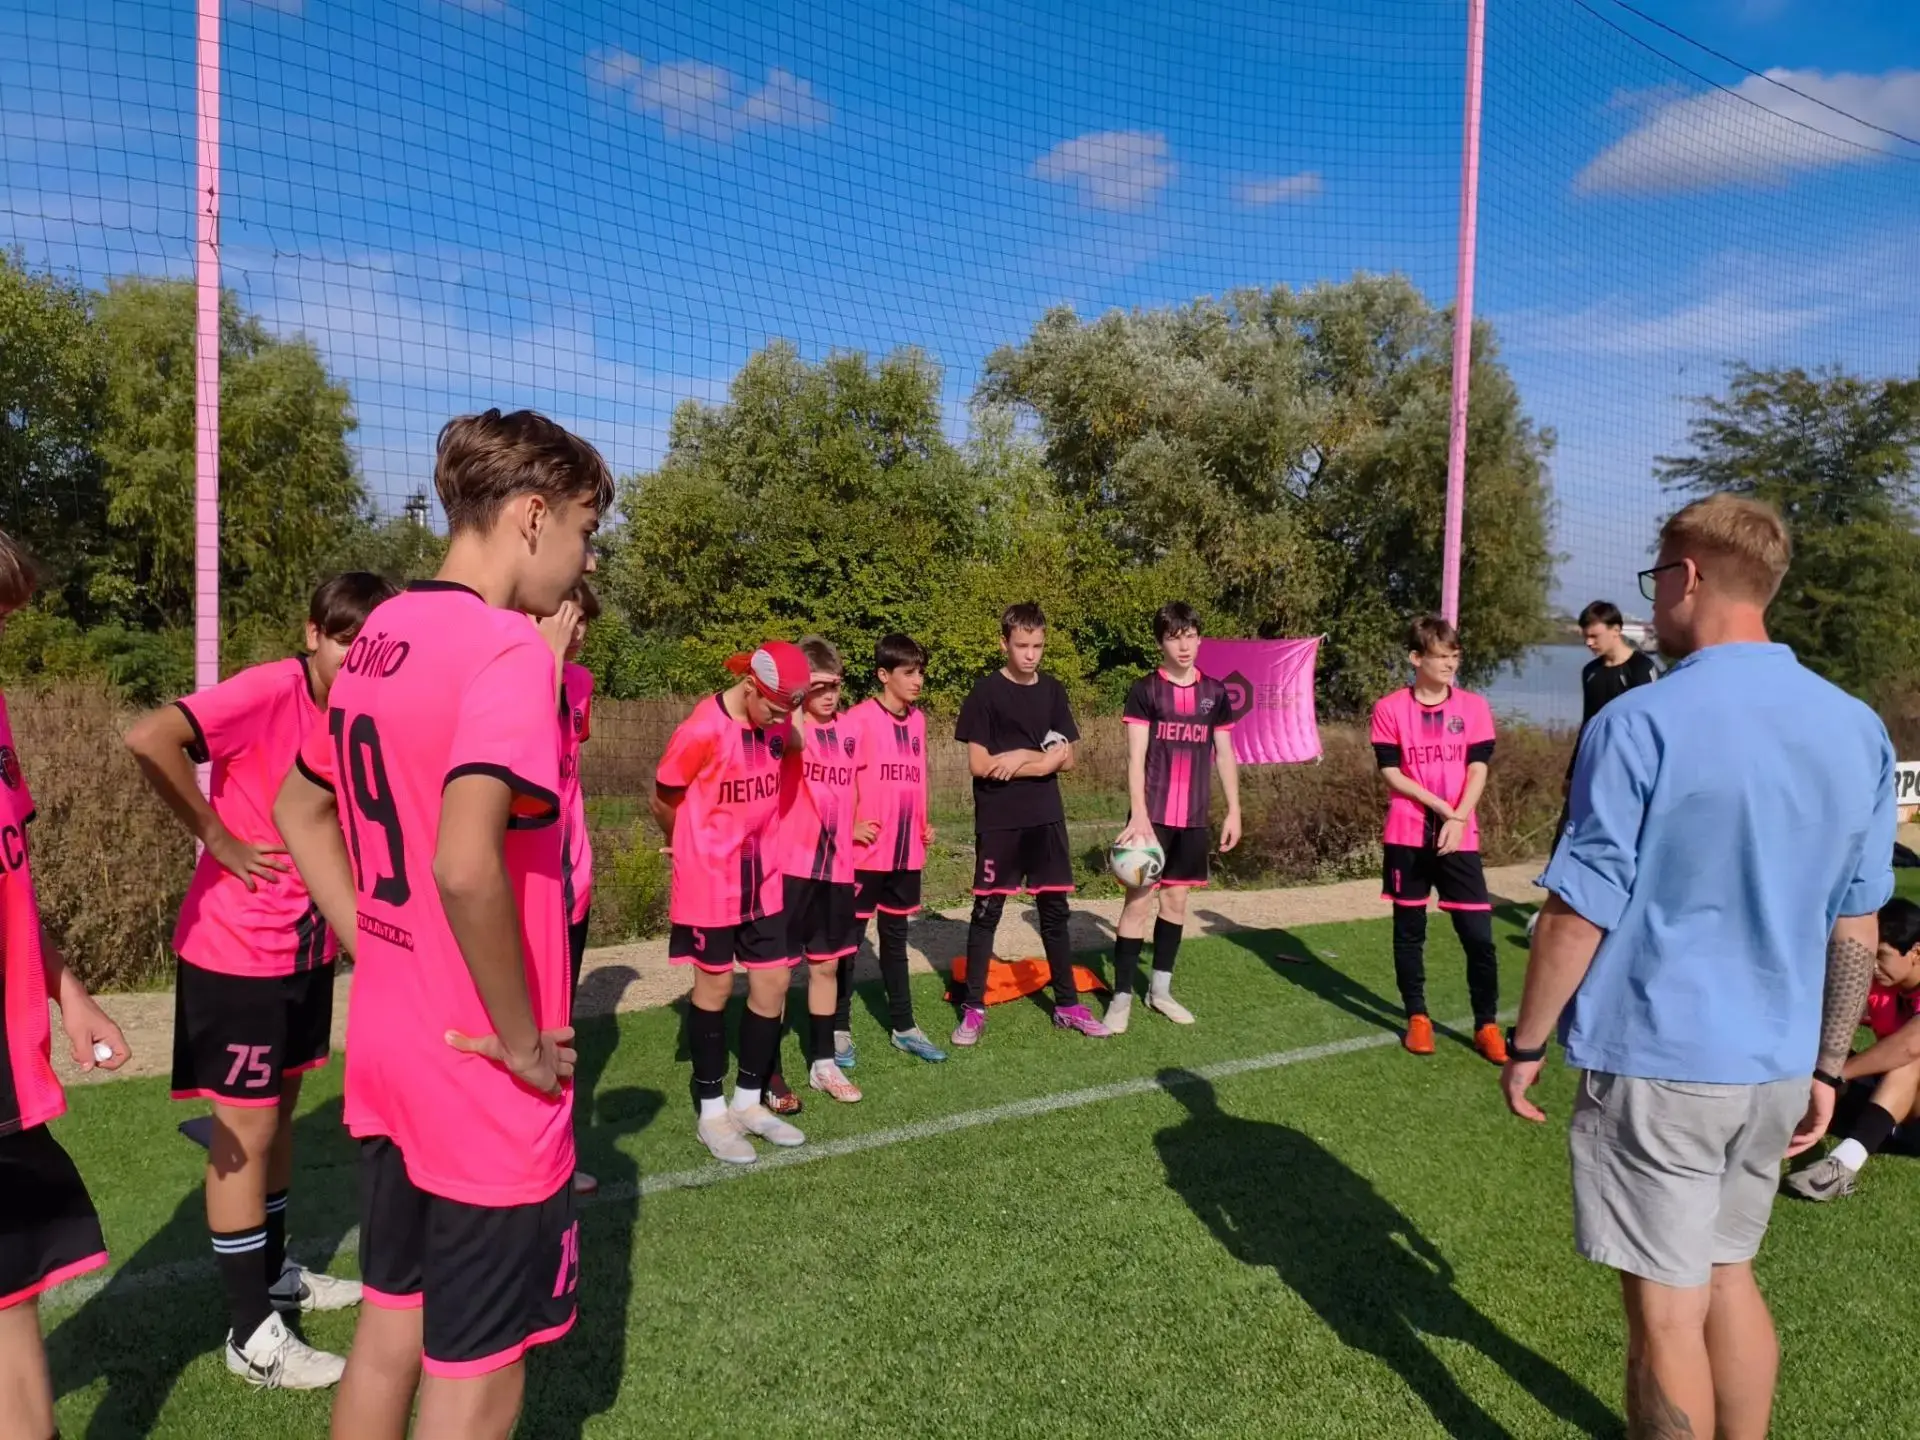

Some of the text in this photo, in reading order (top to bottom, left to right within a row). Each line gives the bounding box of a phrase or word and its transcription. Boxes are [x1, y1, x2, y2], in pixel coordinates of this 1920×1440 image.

[1155, 721, 1208, 742] ЛЕГАСИ
[1407, 744, 1463, 765] ЛЕГАСИ
[880, 764, 920, 784] ЛЕГАСИ
[329, 706, 411, 907] 19
[984, 859, 996, 883] 5
[224, 1043, 272, 1088] 75
